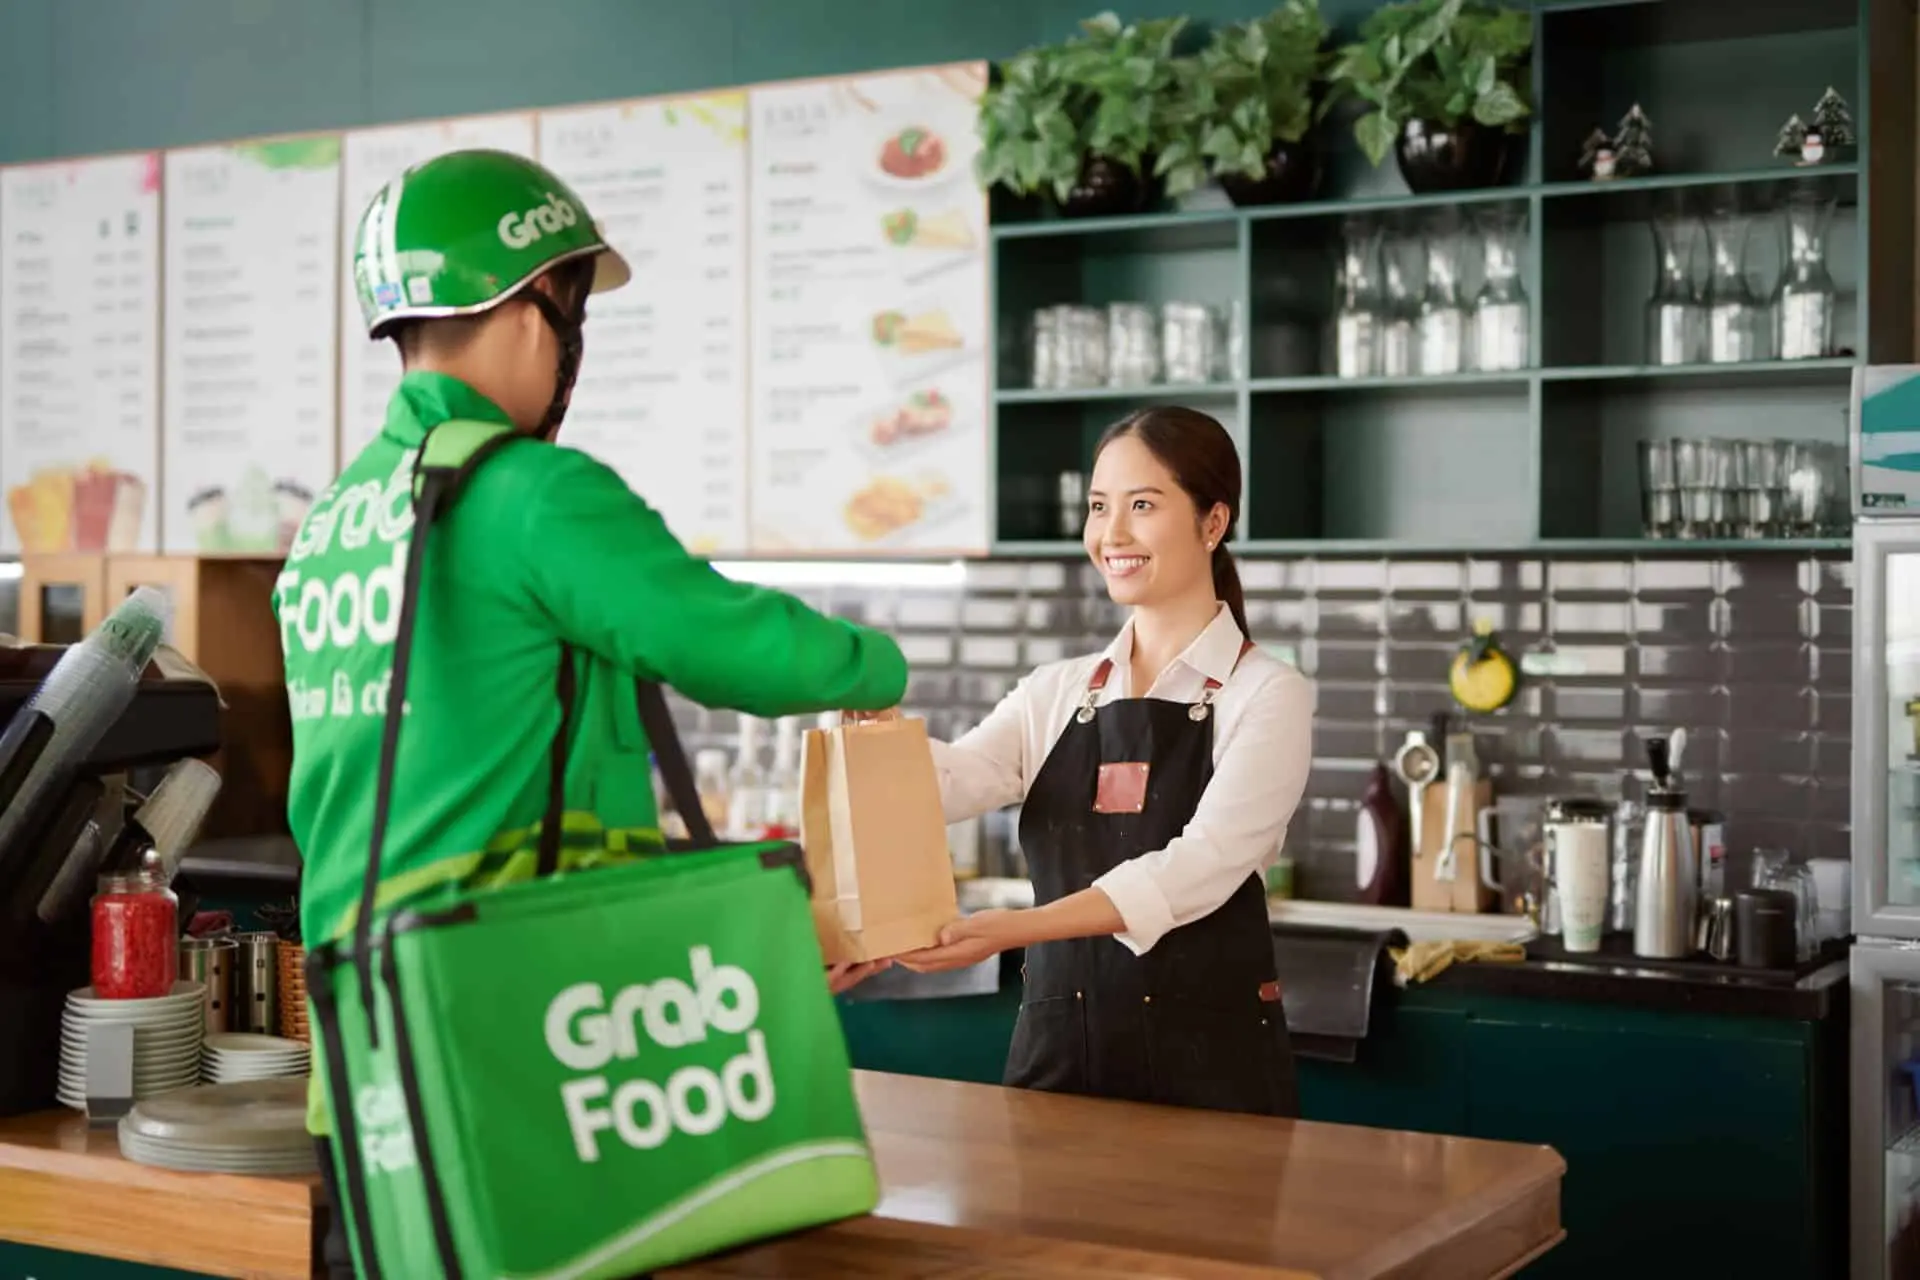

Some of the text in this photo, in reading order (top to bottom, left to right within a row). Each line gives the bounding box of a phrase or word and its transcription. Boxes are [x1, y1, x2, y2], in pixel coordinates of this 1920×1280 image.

[497, 192, 577, 249] Grab
[289, 449, 416, 562] Grab
[276, 540, 408, 656] Food
[544, 944, 760, 1071] Grab
[560, 1028, 776, 1163] Food
